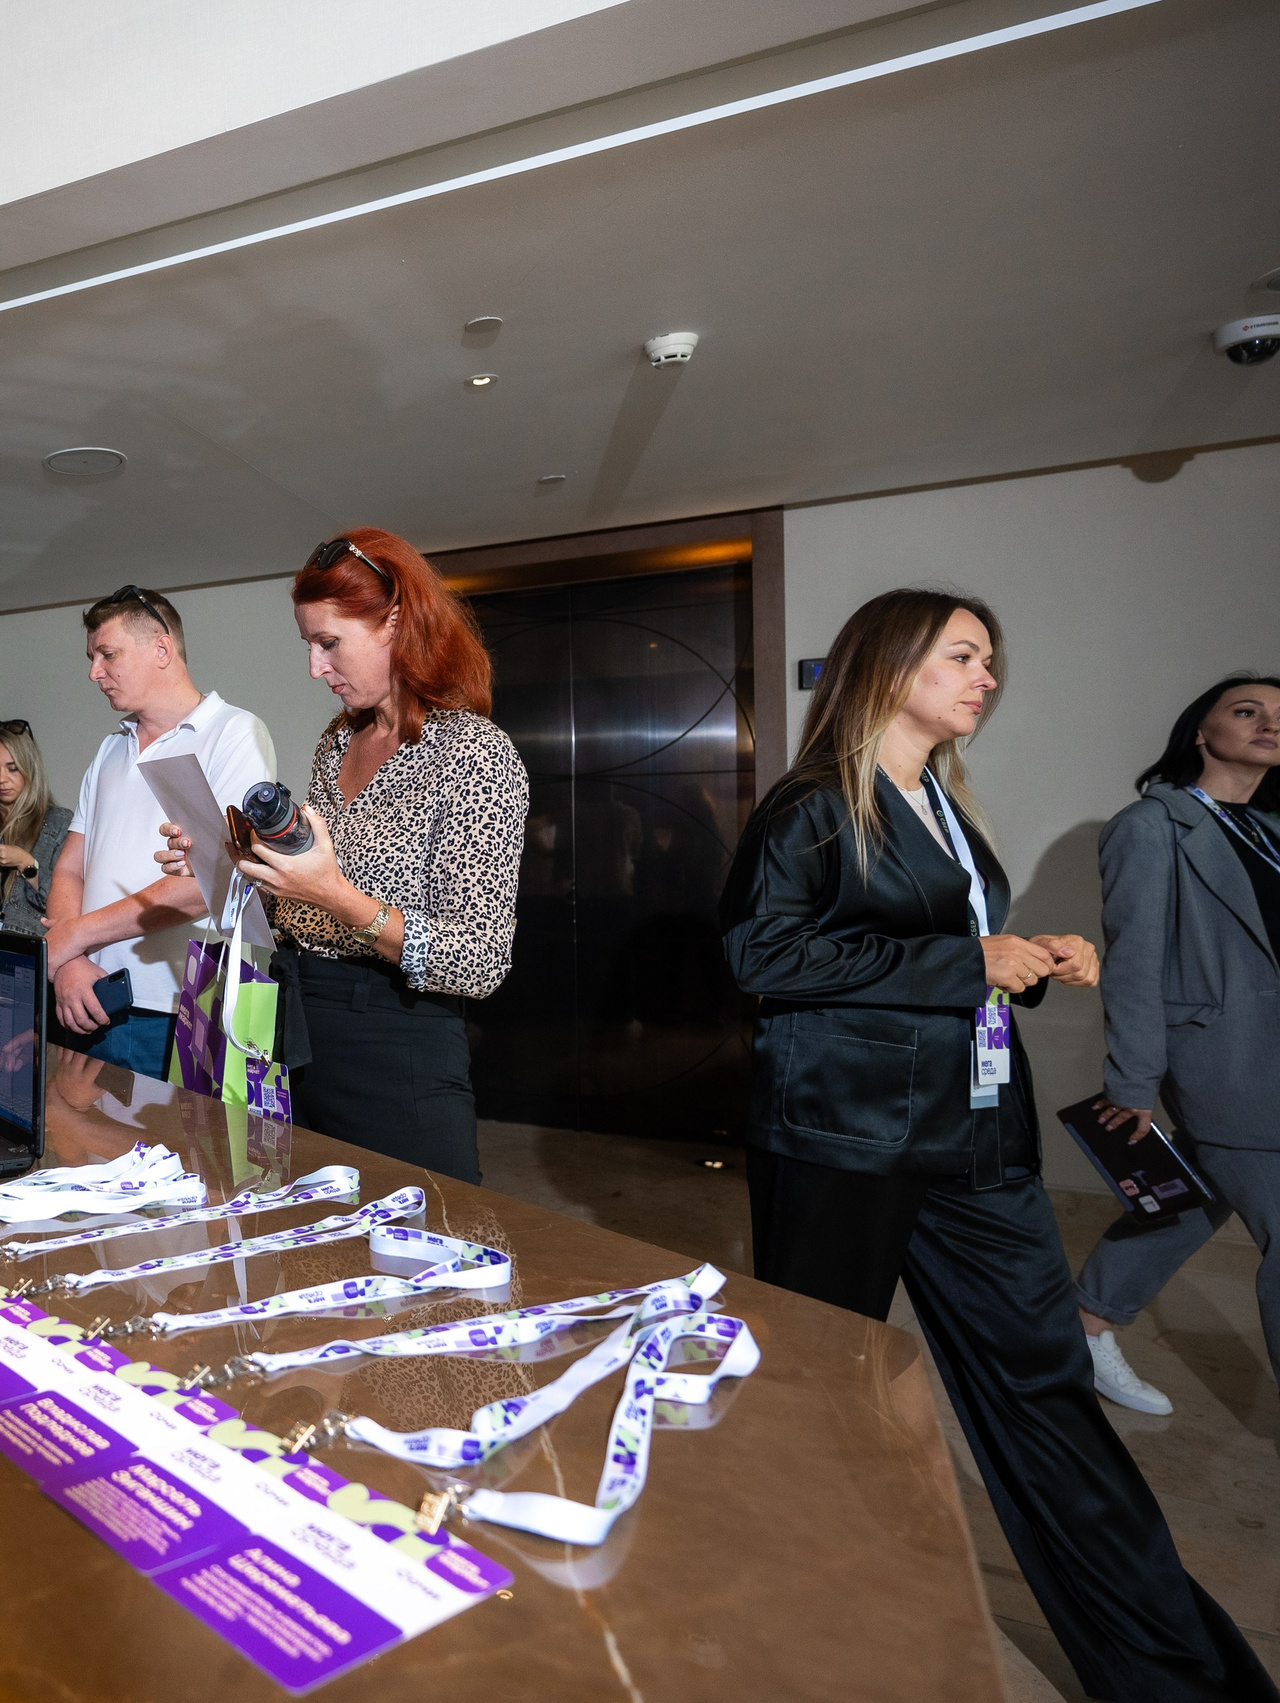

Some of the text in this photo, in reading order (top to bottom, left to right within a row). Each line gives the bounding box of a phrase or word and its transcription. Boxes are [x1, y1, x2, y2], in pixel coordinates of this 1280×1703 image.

[940, 818, 949, 834] СБЕР
[981, 1068, 996, 1076] среда
[111, 1470, 194, 1530] Зиганшин
[128, 1464, 202, 1517] Марсель
[243, 1548, 301, 1587] Алина
